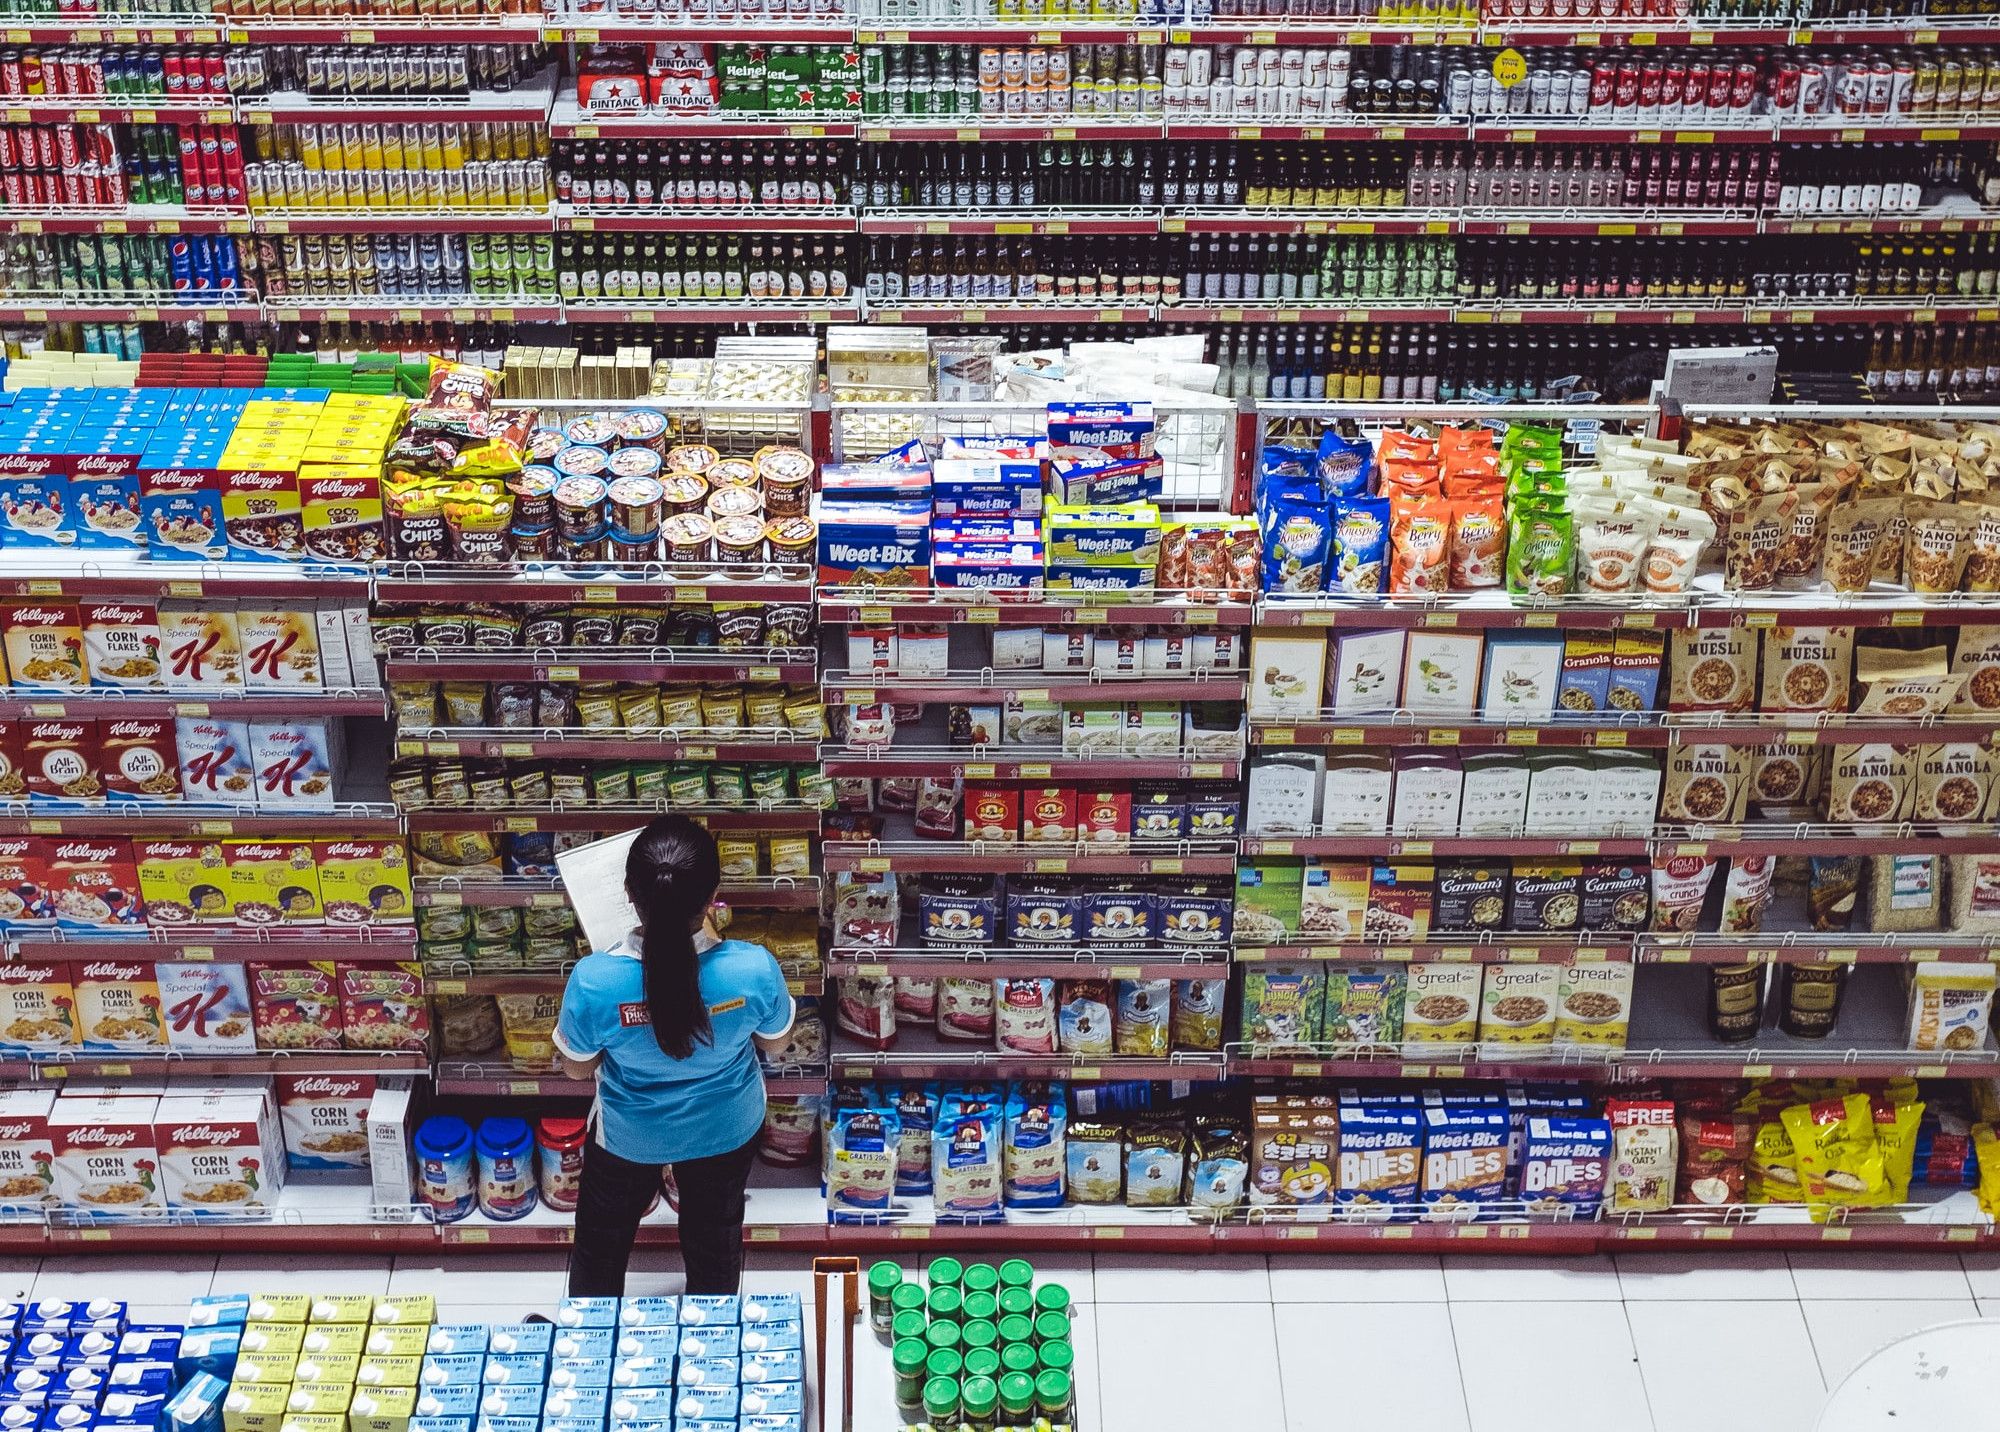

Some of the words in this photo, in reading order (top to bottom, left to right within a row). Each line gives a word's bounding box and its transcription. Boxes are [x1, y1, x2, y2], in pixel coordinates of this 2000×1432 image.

[656, 59, 704, 69] BINTANG
[590, 98, 639, 108] BINTANG
[662, 96, 711, 107] BINTANG
[448, 372, 483, 385] CHOCO
[441, 380, 484, 396] CHIPS
[1075, 409, 1124, 417] Weet-Bix
[964, 439, 1028, 448] Weet-Bix
[1069, 430, 1133, 444] Weet-Bix
[0, 456, 51, 472] Kellogg's
[77, 456, 130, 473] Kellogg's
[151, 470, 204, 487] Kellogg's
[231, 472, 283, 489] Kellogg's
[312, 481, 366, 497] Kellogg's
[963, 499, 1011, 509] Weet-Bix
[404, 519, 439, 528] CHOCO
[400, 529, 443, 542] CHIPS
[462, 532, 497, 541] CHOCO
[962, 527, 1010, 536] Weet-Bix
[1409, 530, 1441, 546] Berry
[460, 541, 503, 553] CHIPS
[1078, 538, 1133, 551] Weet-Bix
[1924, 540, 1952, 550] BITES
[830, 544, 915, 563] Weet-Bix
[957, 572, 1022, 587] Weet-Bix
[1073, 576, 1128, 588] Weet-Bix
[13, 609, 64, 624] Kellogg's
[92, 606, 144, 621] Kellogg's
[181, 616, 213, 626] Kellogg's
[260, 616, 291, 625] Kellogg's
[29, 633, 56, 643] CORN
[106, 632, 138, 643] CORN
[167, 628, 201, 638] Special
[245, 628, 279, 638] Special
[108, 642, 140, 651] FLAKES
[1688, 641, 1742, 656] MUESLI
[170, 631, 220, 680] K
[248, 631, 299, 680] K
[1781, 647, 1836, 660] MUESLI
[1961, 652, 2000, 663] GRAN
[1564, 654, 1611, 668] Granola
[1613, 655, 1660, 667] Granola
[1885, 684, 1941, 695] MUESLI
[32, 725, 84, 738] Kellogg's
[111, 722, 161, 737] Kellogg's
[193, 726, 229, 738] Kellogg's
[269, 732, 306, 742] Kellogg's
[185, 741, 217, 751] Special
[260, 748, 295, 757] Special
[54, 758, 74, 768] All-
[127, 762, 156, 773] Bran
[132, 756, 152, 766] All-
[1673, 761, 1741, 774] GRANOLA
[1924, 761, 1991, 774] GRANOLA
[50, 764, 79, 775] Bran
[188, 746, 235, 791] K
[262, 750, 313, 797] K
[1839, 764, 1907, 777] GRANOLA
[56, 844, 116, 861] Kellogg's
[146, 843, 192, 857] Kellogg's
[236, 844, 282, 858] Kellogg's
[327, 843, 374, 857] Kellogg's
[1033, 886, 1056, 894] Ligo
[1440, 878, 1503, 894] Carman's
[1514, 877, 1577, 893] Carman's
[1585, 876, 1646, 893] Carman's
[945, 887, 967, 896] Ligo
[1670, 889, 1699, 899] crunch
[0, 965, 53, 980] Kellogg's
[83, 964, 141, 980] Kellogg's
[181, 969, 219, 980] Kellogg's
[1495, 969, 1539, 988] great
[1568, 967, 1613, 987] great
[1417, 970, 1462, 990] great
[101, 989, 132, 1000] CORN
[166, 983, 207, 993] Special
[12, 991, 44, 1002] CORN
[15, 1000, 46, 1009] FLAKES
[102, 999, 134, 1008] FLAKES
[169, 984, 230, 1037] K
[294, 1077, 360, 1096] Kellogg's
[311, 1107, 348, 1120] CORN
[1450, 1116, 1485, 1124] Weet-Bix
[1628, 1107, 1673, 1124] FREE
[312, 1117, 349, 1128] FLAKES
[67, 1128, 135, 1147] Kellogg's
[172, 1125, 241, 1144] Kellogg's
[1341, 1133, 1415, 1148] Weet-Bix
[1429, 1132, 1502, 1148] Weet-Bix
[1552, 1130, 1588, 1139] Weet-Bix
[1529, 1144, 1604, 1157] Weet-Bix
[1623, 1147, 1664, 1157] INSTANT
[87, 1157, 124, 1170] CORN
[192, 1156, 229, 1168] CORN
[1632, 1156, 1656, 1165] OATS
[89, 1168, 126, 1178] FLAKES
[194, 1166, 231, 1177] FLAKES
[1340, 1150, 1415, 1189] BITES
[1428, 1151, 1501, 1190] BITES
[1526, 1159, 1601, 1191] BITES
